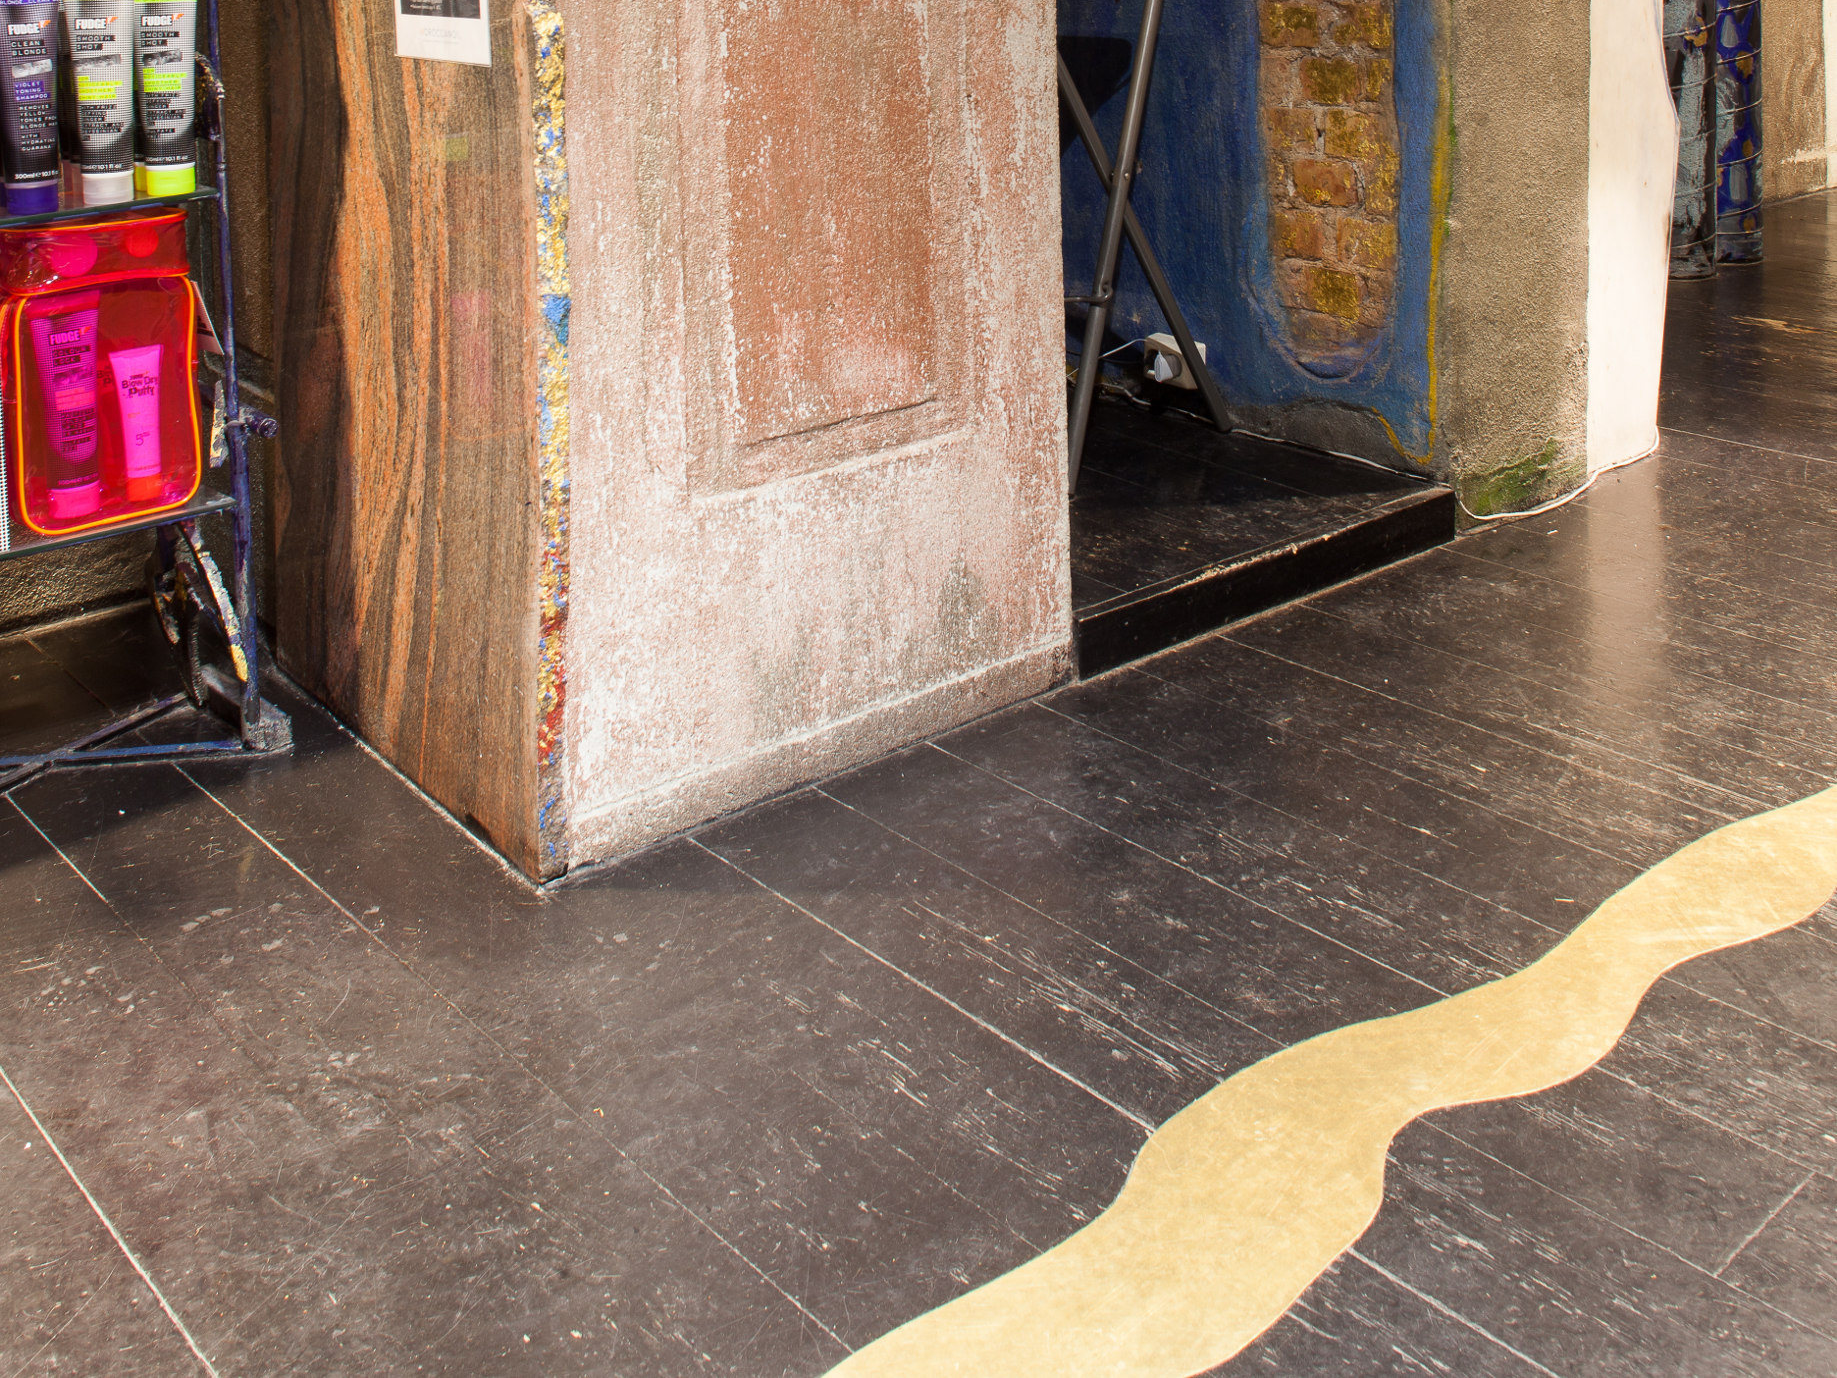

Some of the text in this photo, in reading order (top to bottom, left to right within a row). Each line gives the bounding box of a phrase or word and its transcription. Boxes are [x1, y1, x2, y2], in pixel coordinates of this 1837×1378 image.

[75, 18, 107, 31] FUDGE
[141, 15, 173, 27] FUDGE
[8, 22, 40, 36] FUDGE
[77, 34, 111, 42] SMOOTH
[141, 31, 176, 39] SMOOTH
[11, 40, 41, 48] CLEAN
[77, 43, 99, 51] SHOT
[141, 39, 164, 47] SHOT
[12, 48, 47, 56] BLONDE
[16, 93, 48, 101] SHAMPOO
[49, 329, 81, 346] FUDGE
[53, 346, 87, 357] COLOUR
[54, 357, 76, 366] LOCK
[121, 379, 143, 389] Blow
[128, 386, 155, 397] Putty
